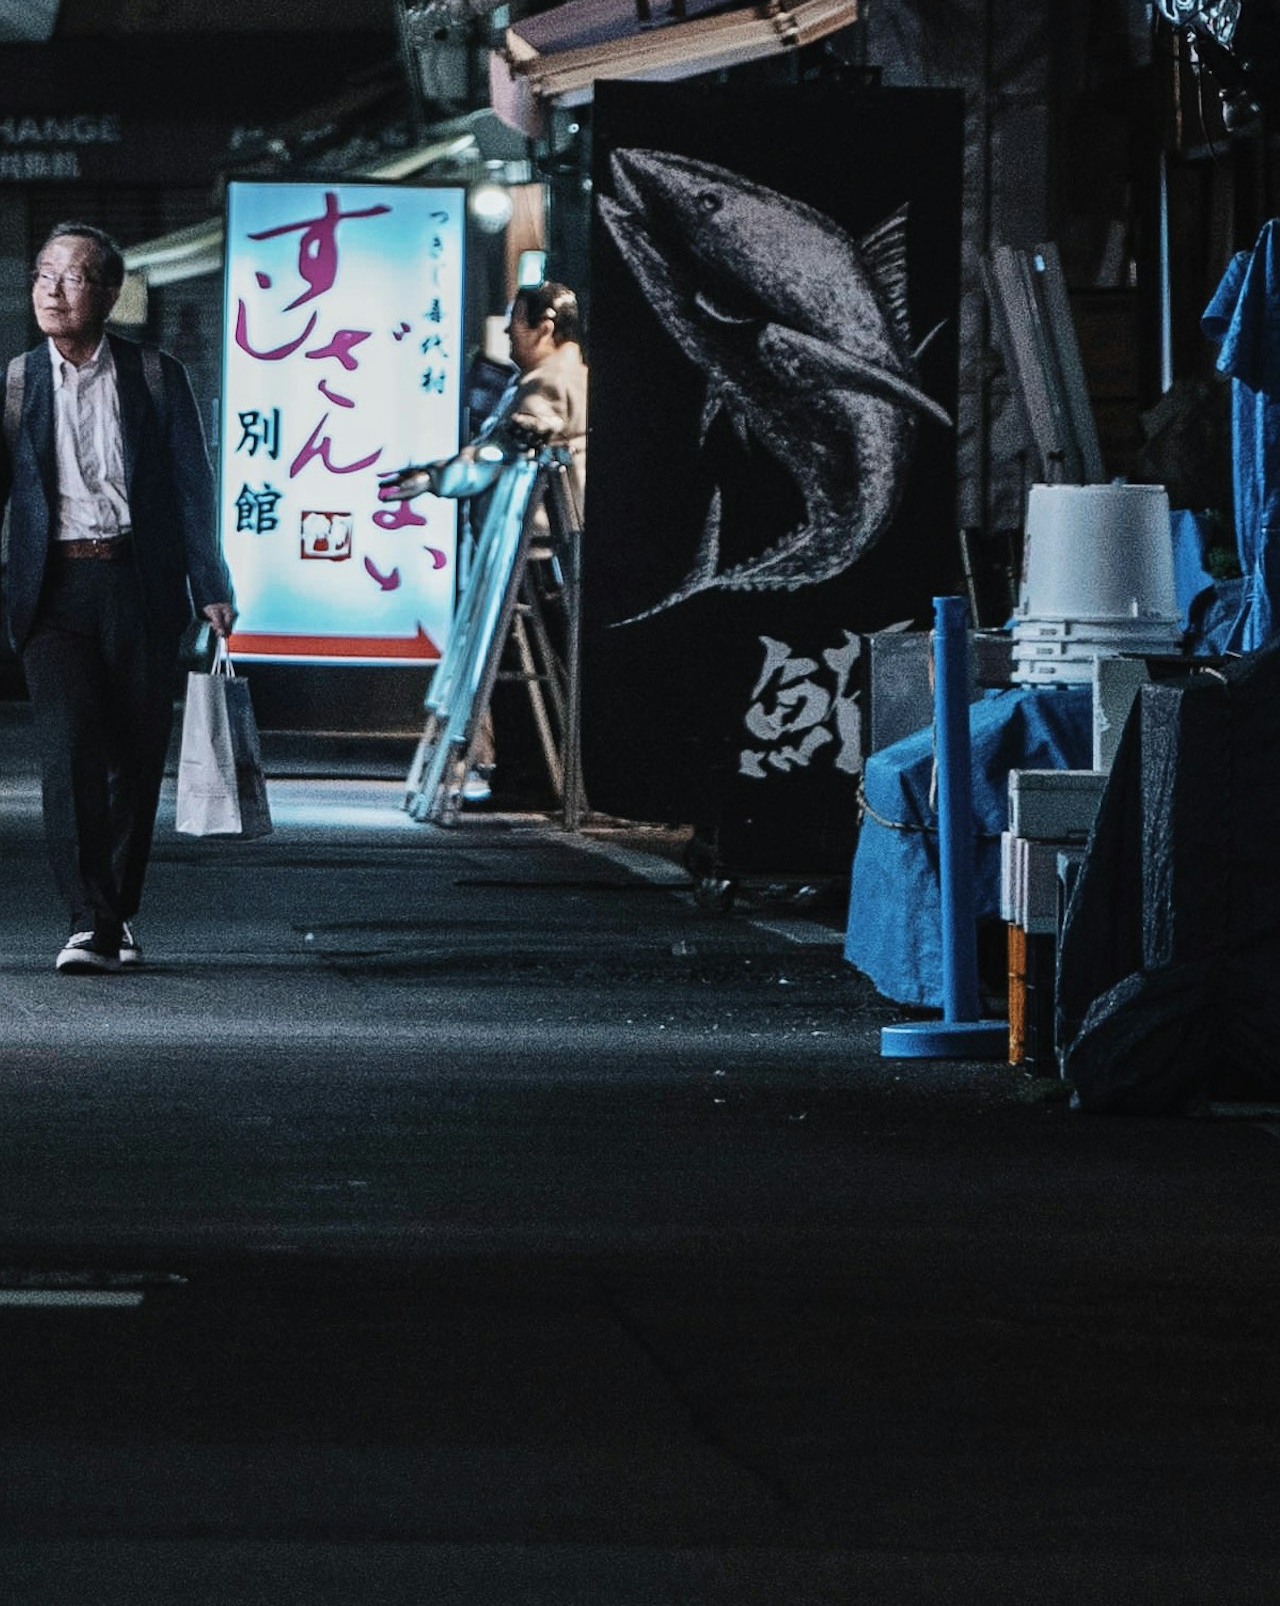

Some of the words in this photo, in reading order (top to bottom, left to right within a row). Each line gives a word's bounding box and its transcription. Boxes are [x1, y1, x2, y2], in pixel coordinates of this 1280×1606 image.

[234, 191, 447, 592] すしざんまい
[234, 407, 284, 536] 別館
